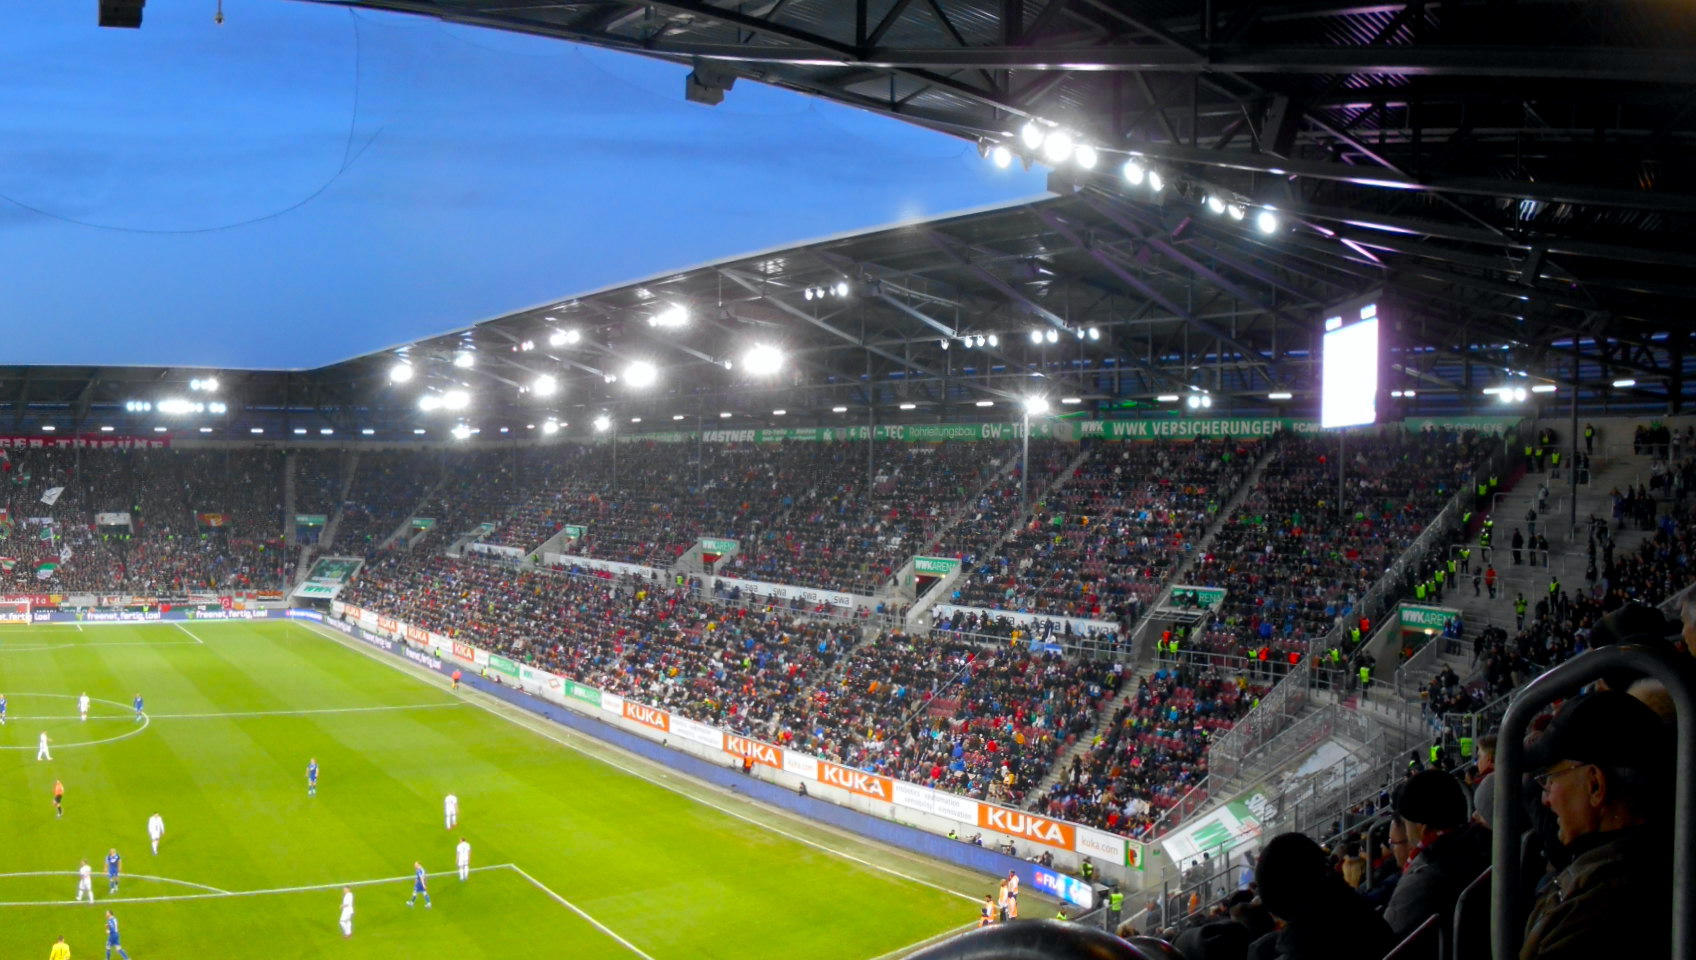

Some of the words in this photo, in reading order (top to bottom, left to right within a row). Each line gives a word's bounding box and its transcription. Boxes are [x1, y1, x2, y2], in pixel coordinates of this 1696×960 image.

[703, 429, 755, 442] KASTNER
[908, 426, 977, 438] Rohrleitungsbau
[1113, 422, 1147, 436] WWK
[1152, 420, 1282, 435] VERSICHERUNGEN
[627, 703, 665, 728] KUKA
[728, 736, 778, 765] KUKA
[824, 763, 885, 798] KUKA
[988, 806, 1066, 845] KUKA
[1081, 836, 1119, 855] kuka.com
